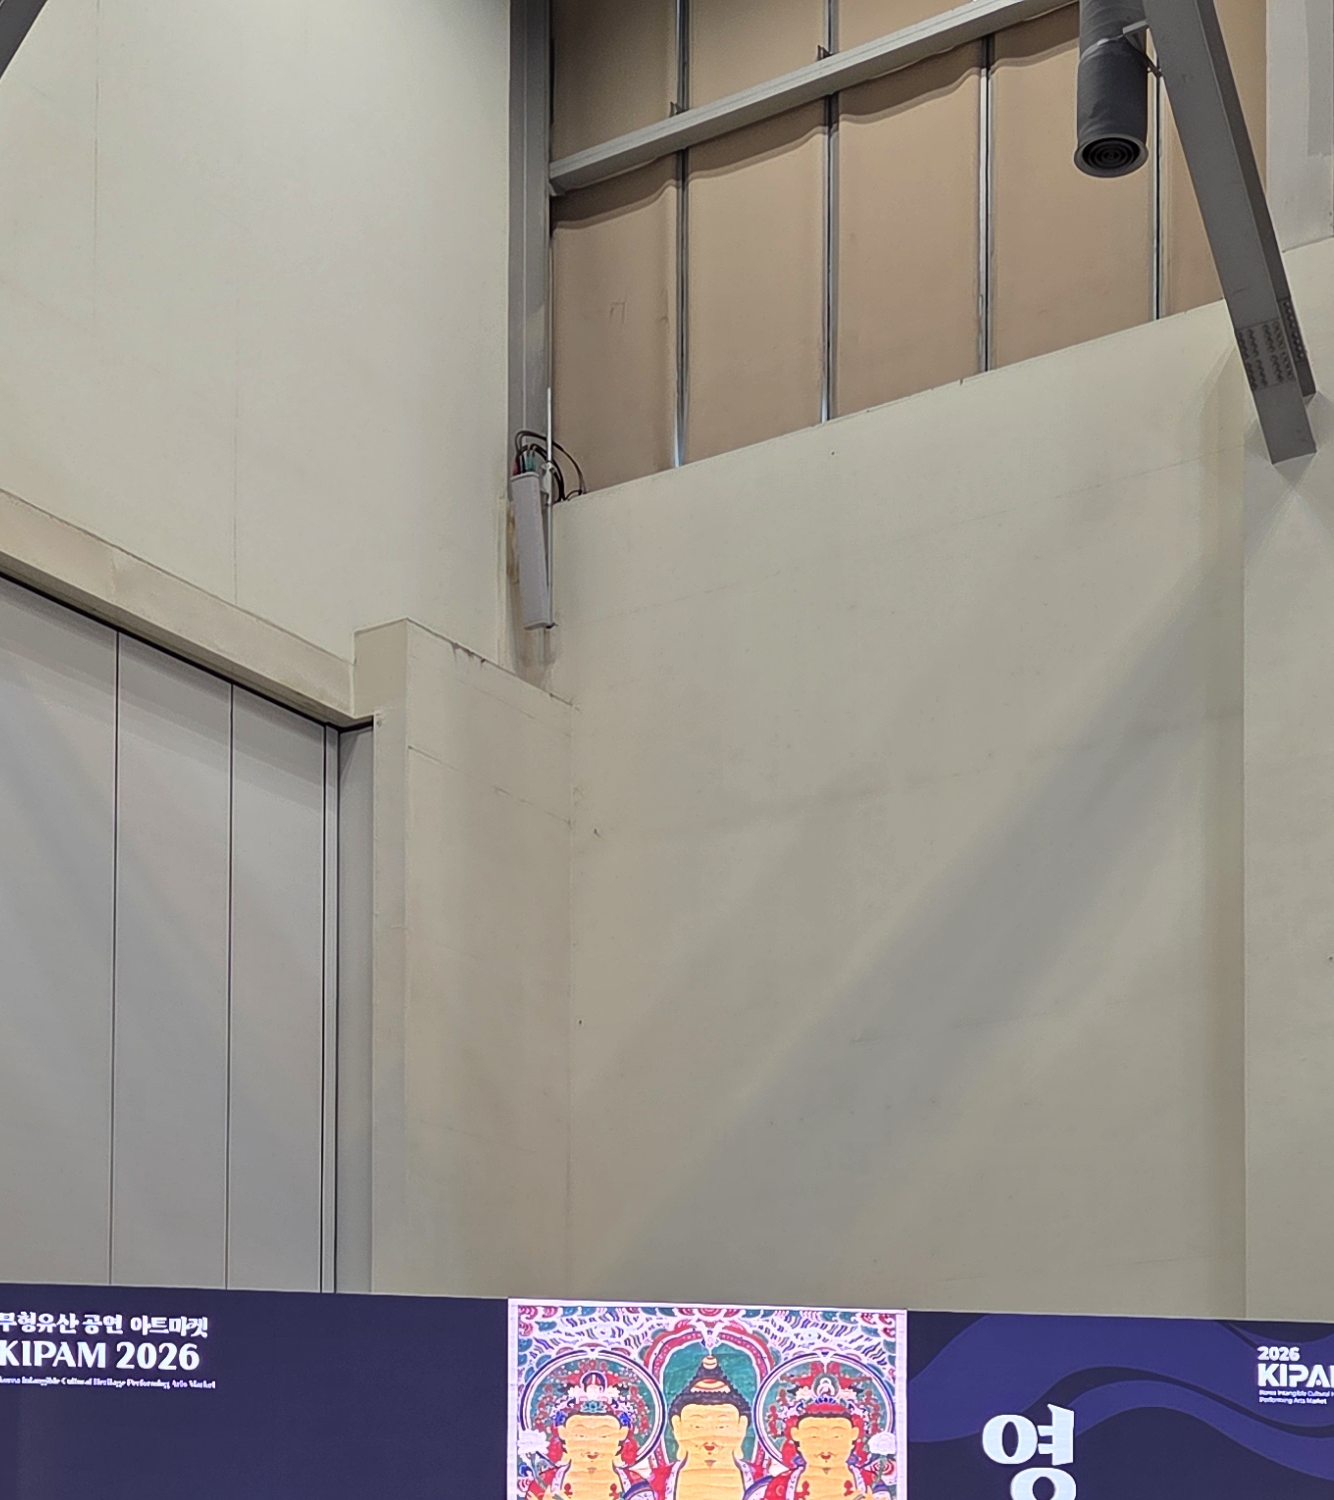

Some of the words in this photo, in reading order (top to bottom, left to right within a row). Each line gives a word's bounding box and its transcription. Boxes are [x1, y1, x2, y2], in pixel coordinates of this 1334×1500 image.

[82, 1313, 123, 1335] 공연
[130, 1315, 208, 1338] 아트마켓
[116, 1341, 200, 1371] 2026
[1257, 1346, 1300, 1361] 2026
